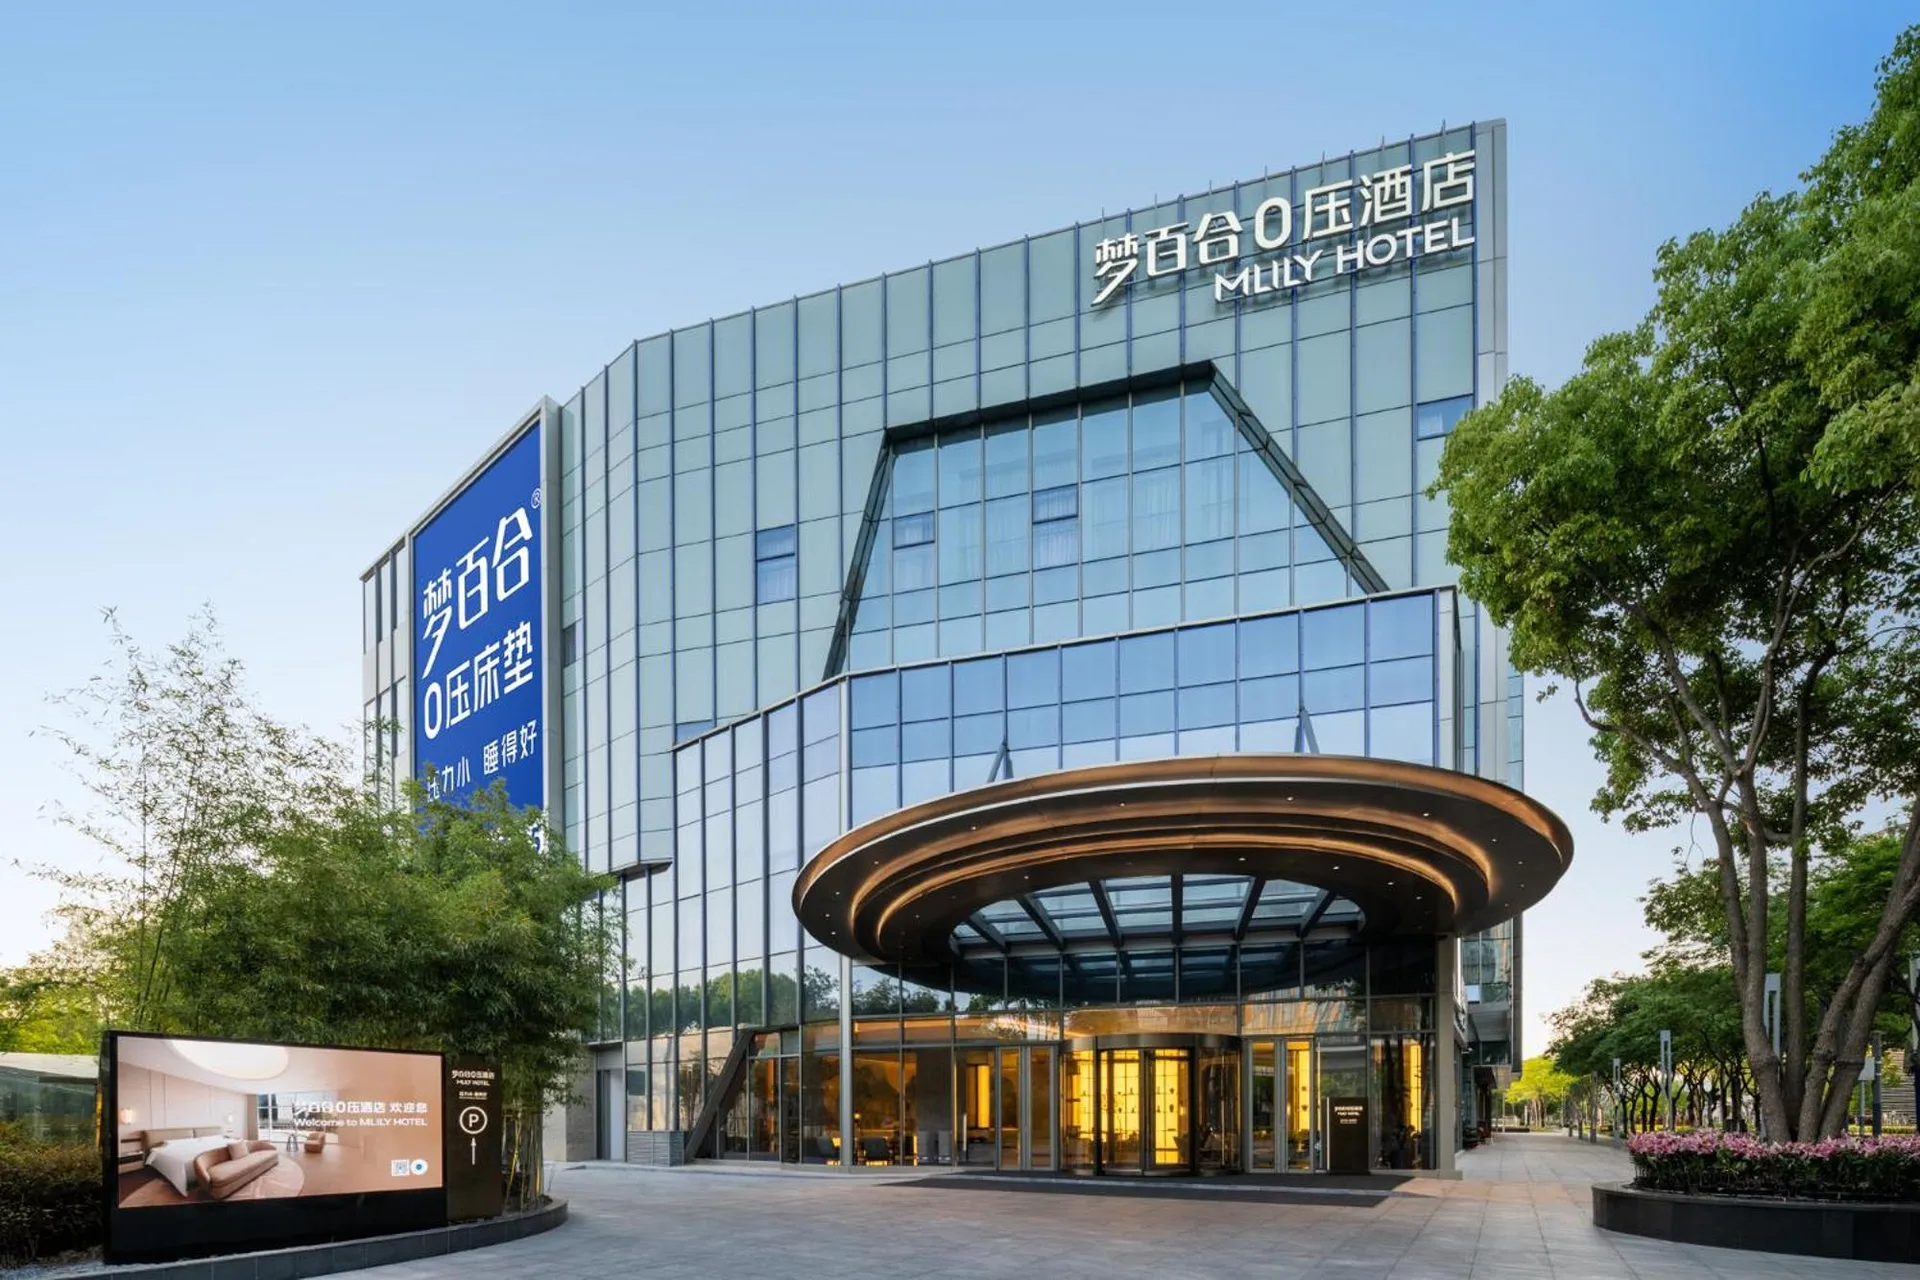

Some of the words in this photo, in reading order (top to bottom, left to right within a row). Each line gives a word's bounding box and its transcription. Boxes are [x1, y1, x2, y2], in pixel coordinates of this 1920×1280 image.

[1214, 249, 1324, 302] MLILY
[1336, 216, 1476, 276] HOTEL
[483, 719, 537, 776] 睡得好
[294, 1117, 345, 1127] Welcome
[346, 1118, 358, 1127] to
[359, 1117, 392, 1127] MLILY
[393, 1117, 429, 1127] HOTEL
[469, 1113, 480, 1128] P
